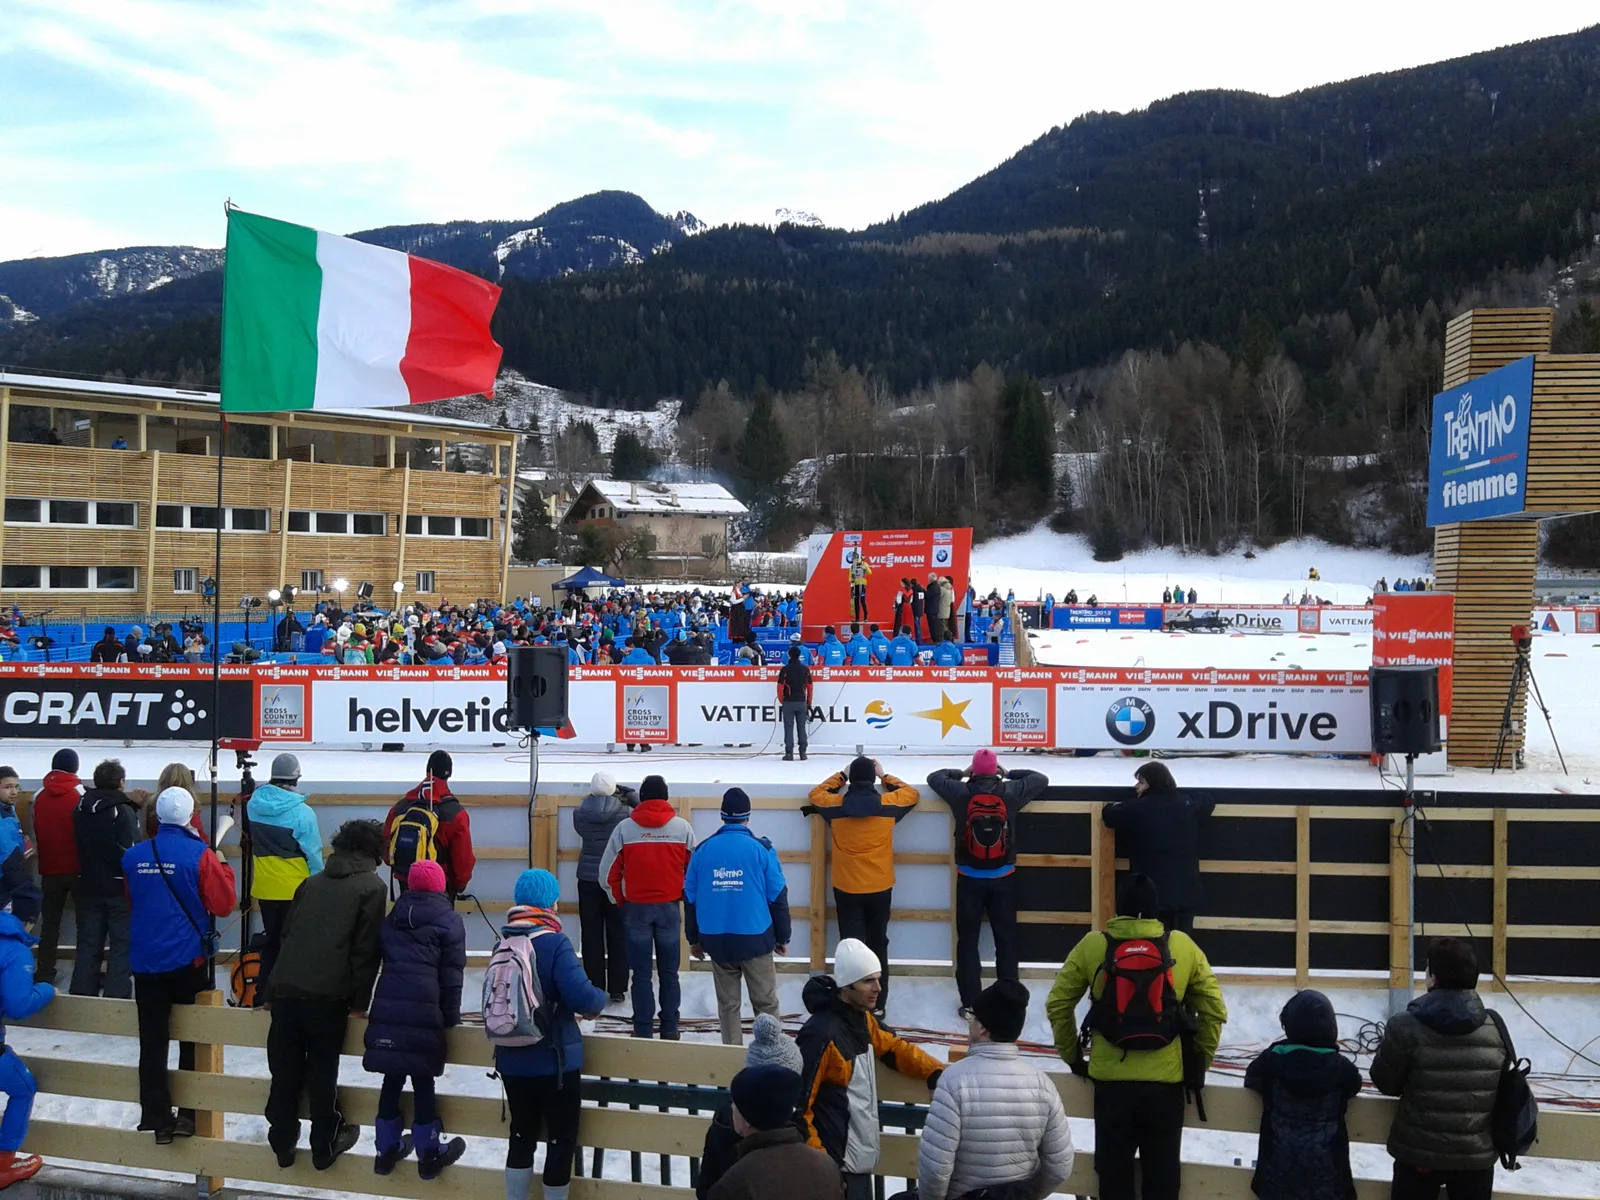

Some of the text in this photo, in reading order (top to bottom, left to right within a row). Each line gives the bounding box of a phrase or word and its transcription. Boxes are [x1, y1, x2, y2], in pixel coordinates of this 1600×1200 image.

[1443, 393, 1517, 460] TRENTINO
[1442, 471, 1518, 508] fiemme
[869, 552, 925, 568] VIESSMANN
[1388, 628, 1452, 644] VIESSMANN
[22, 664, 73, 677] VIESSMANN
[80, 664, 131, 677] VIESSMANN
[138, 665, 190, 678] VIESSMANN
[257, 666, 309, 679] VIESSMANN
[316, 667, 369, 680] VIESSMANN
[376, 668, 429, 680] VIESSMANN
[436, 667, 489, 680] VIESSMANN
[619, 667, 673, 680] VIESSMANN
[681, 668, 735, 681] VIESSMANN
[868, 668, 923, 680] VIESSMANN
[931, 668, 987, 681] VIESSMANN
[996, 669, 1052, 682] VIESSMANN
[1060, 669, 1117, 683] VIESSMANN
[1126, 670, 1183, 684] VIESSMANN
[1192, 670, 1250, 684] VIESSMANN
[1259, 671, 1318, 684] VIESSMANN
[4, 691, 164, 725] CRAFT
[1110, 698, 1152, 714] BMW
[700, 705, 857, 722] VATTEALL
[1176, 701, 1338, 741] xDrive
[264, 728, 301, 737] VIESSMANN
[628, 728, 666, 738] VIESSMANN
[1004, 731, 1044, 742] VIESSMANN
